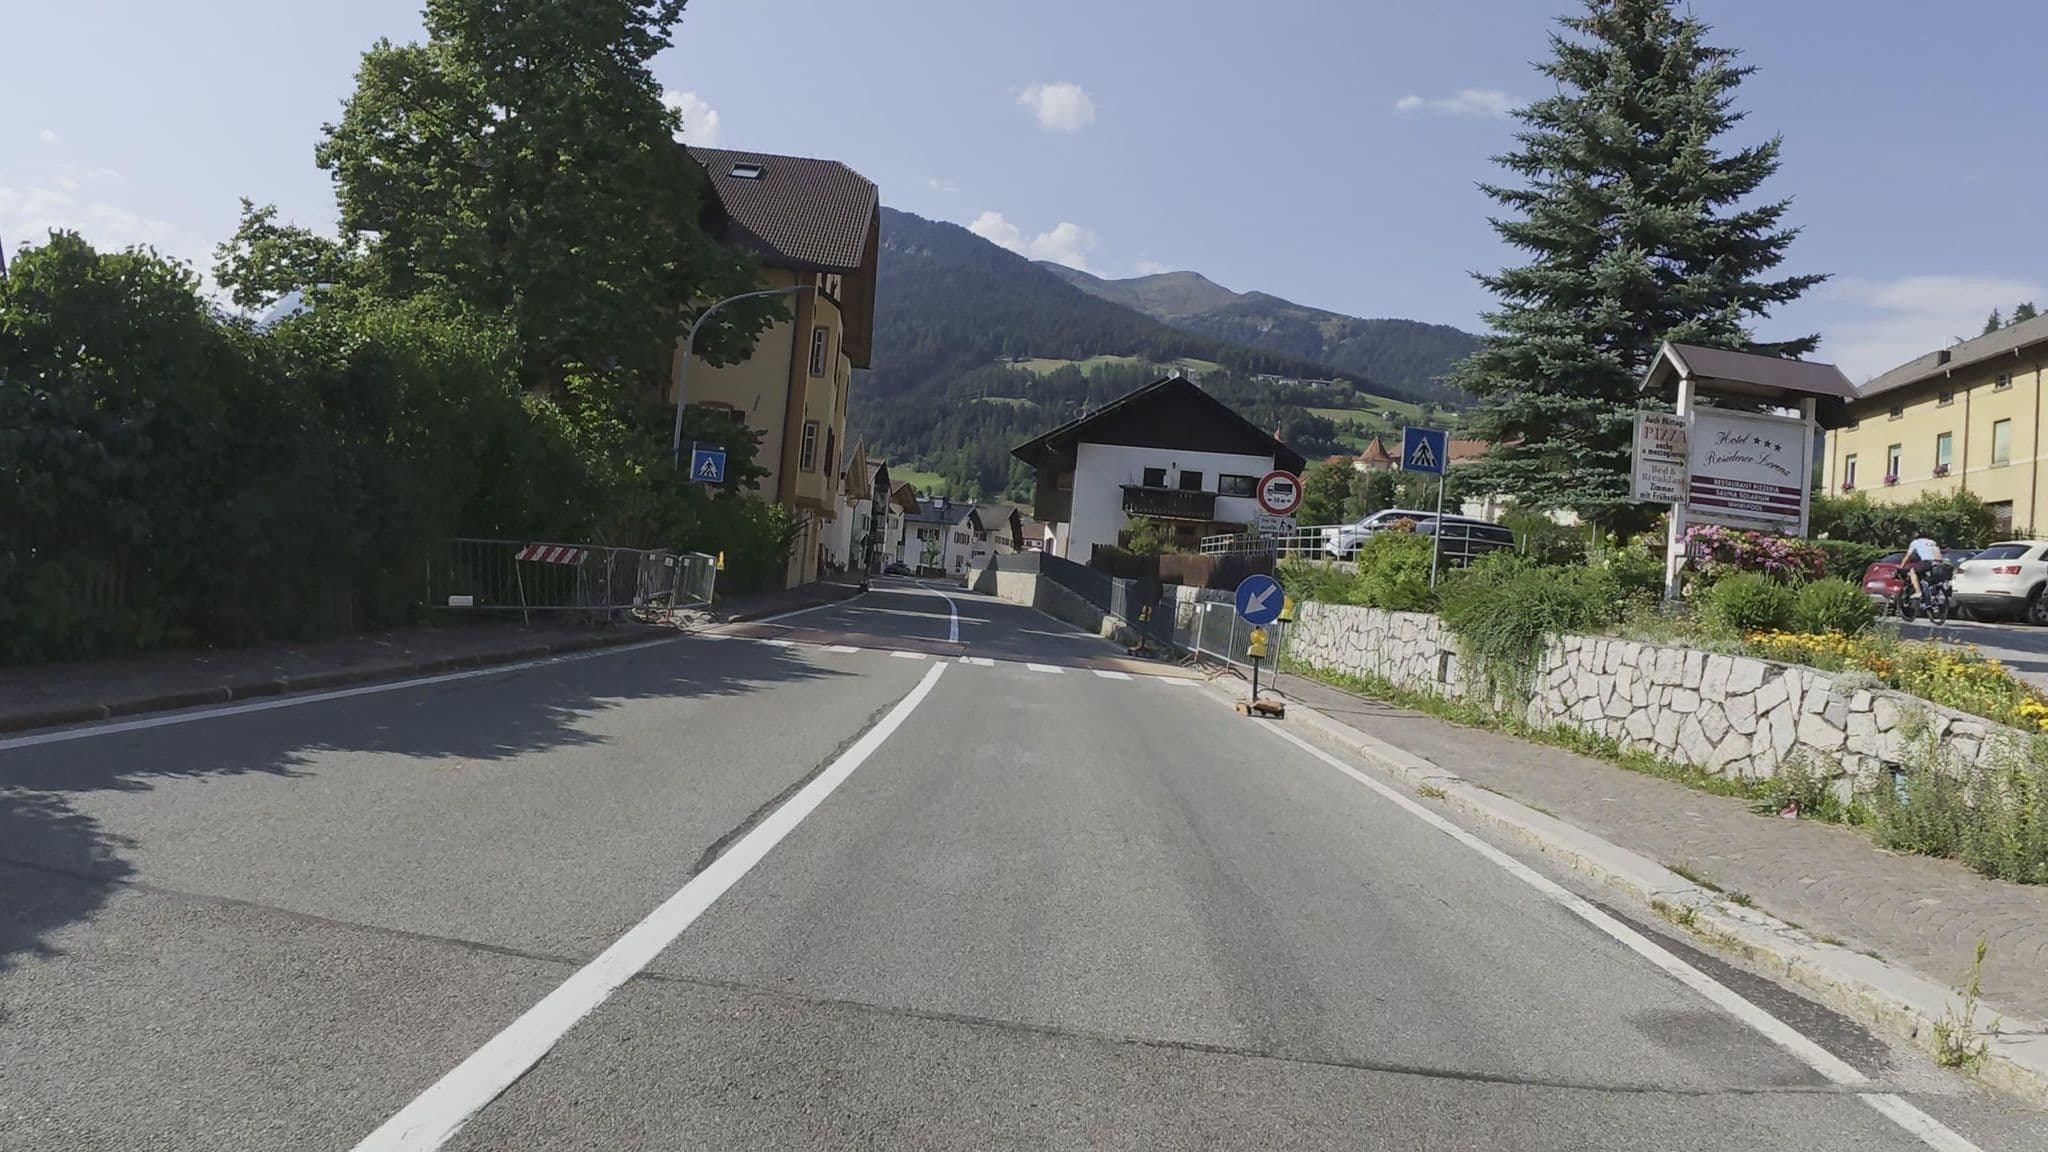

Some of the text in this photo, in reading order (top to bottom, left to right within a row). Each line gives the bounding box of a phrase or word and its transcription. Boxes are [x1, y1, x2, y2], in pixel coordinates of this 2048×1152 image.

[1644, 426, 1686, 443] PIZZA
[1715, 430, 1750, 446] Hotel
[1656, 442, 1672, 451] anche
[1704, 450, 1754, 466] Residence
[1652, 464, 1668, 474] Bed
[1642, 473, 1684, 484] Breakfast
[1650, 482, 1674, 492] Zimmer
[1714, 479, 1780, 492] RESTAURANT PIZZERIA
[1716, 490, 1770, 502] SAUNA SOLARIUM
